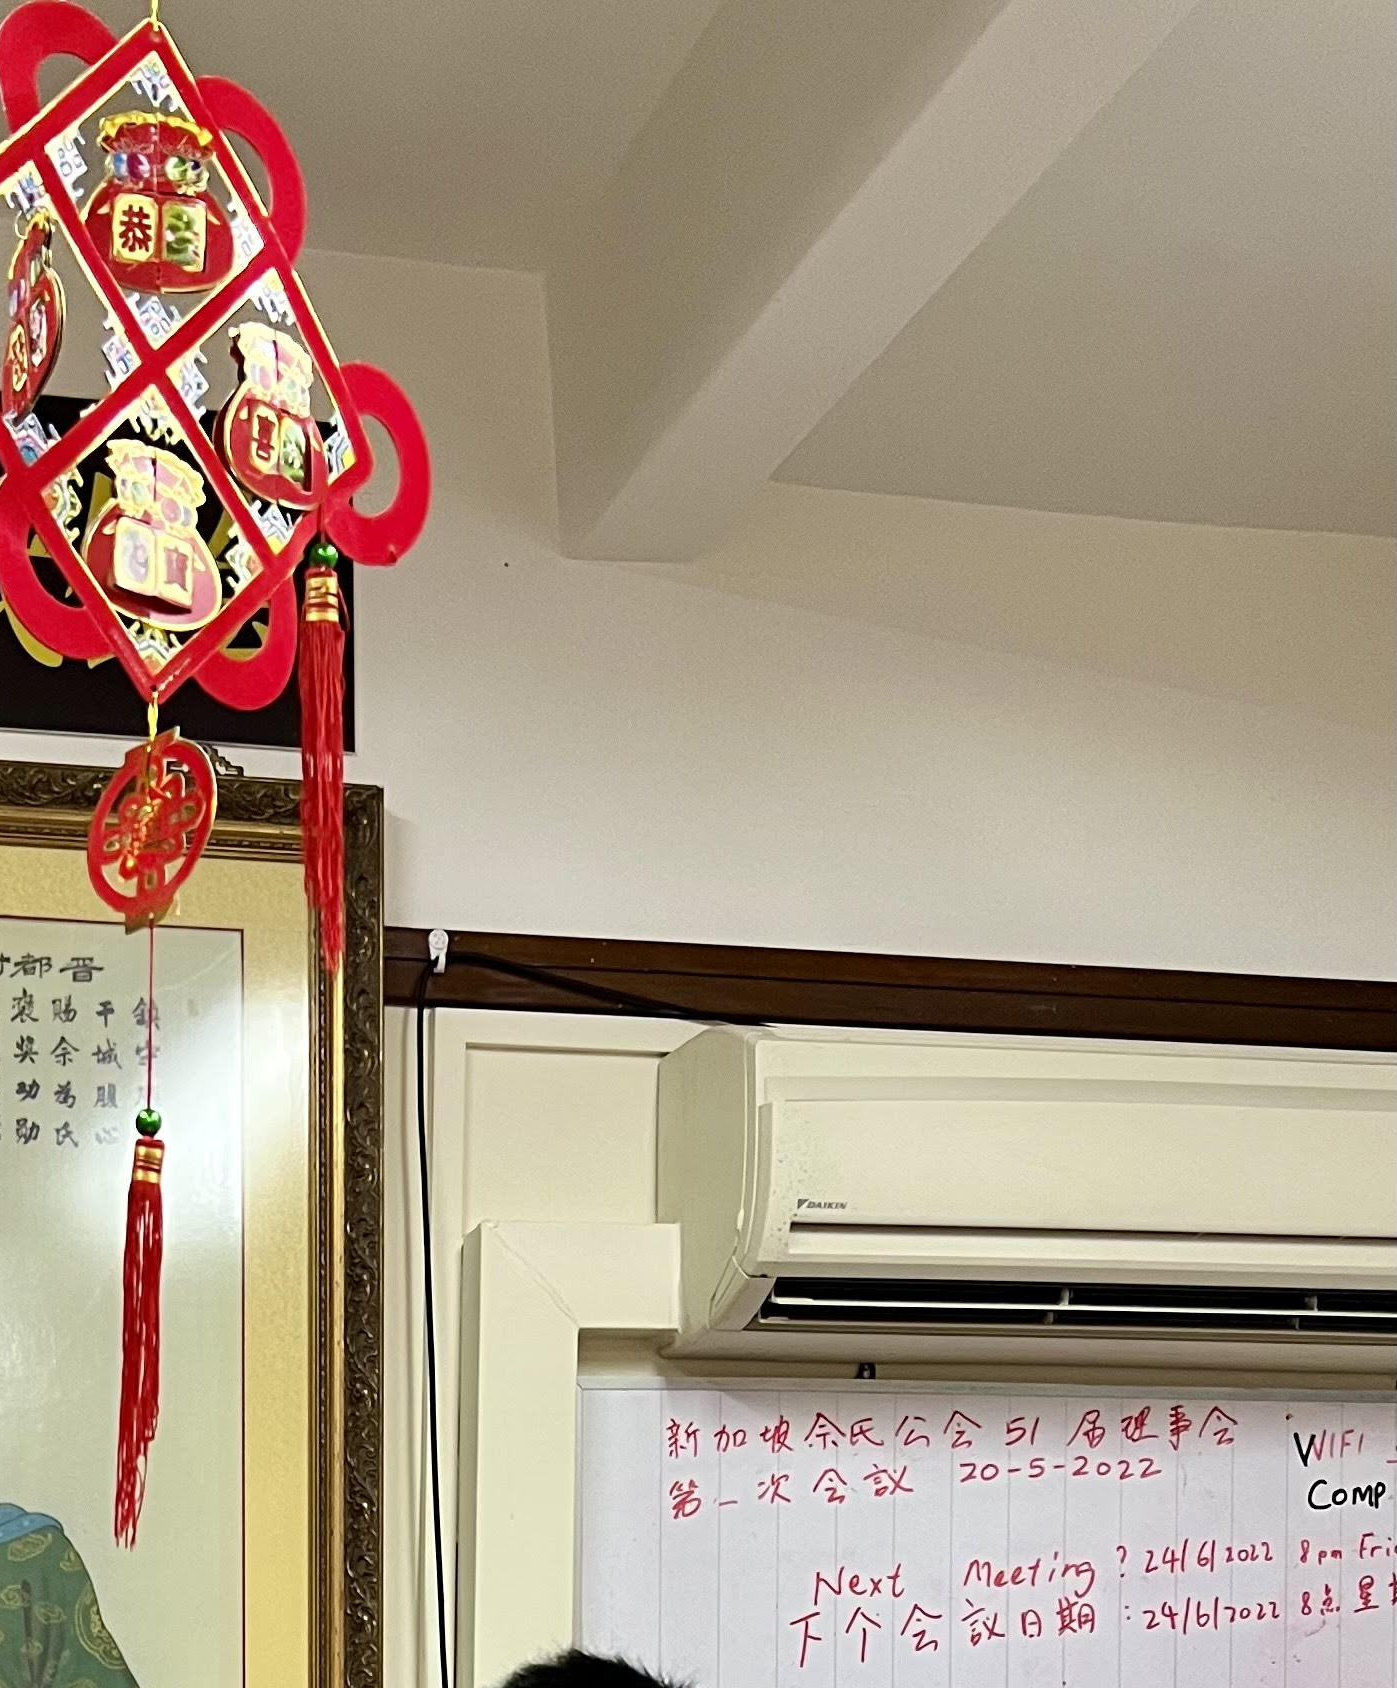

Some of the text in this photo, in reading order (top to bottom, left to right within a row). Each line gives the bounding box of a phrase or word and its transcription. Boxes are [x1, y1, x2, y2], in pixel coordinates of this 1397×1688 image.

[806, 1201, 847, 1210] DAIKIN
[1005, 1416, 1039, 1446] 51
[959, 1455, 1162, 1483] 20-5-2022
[813, 1564, 906, 1606] Next
[963, 1551, 1096, 1598] Meeting
